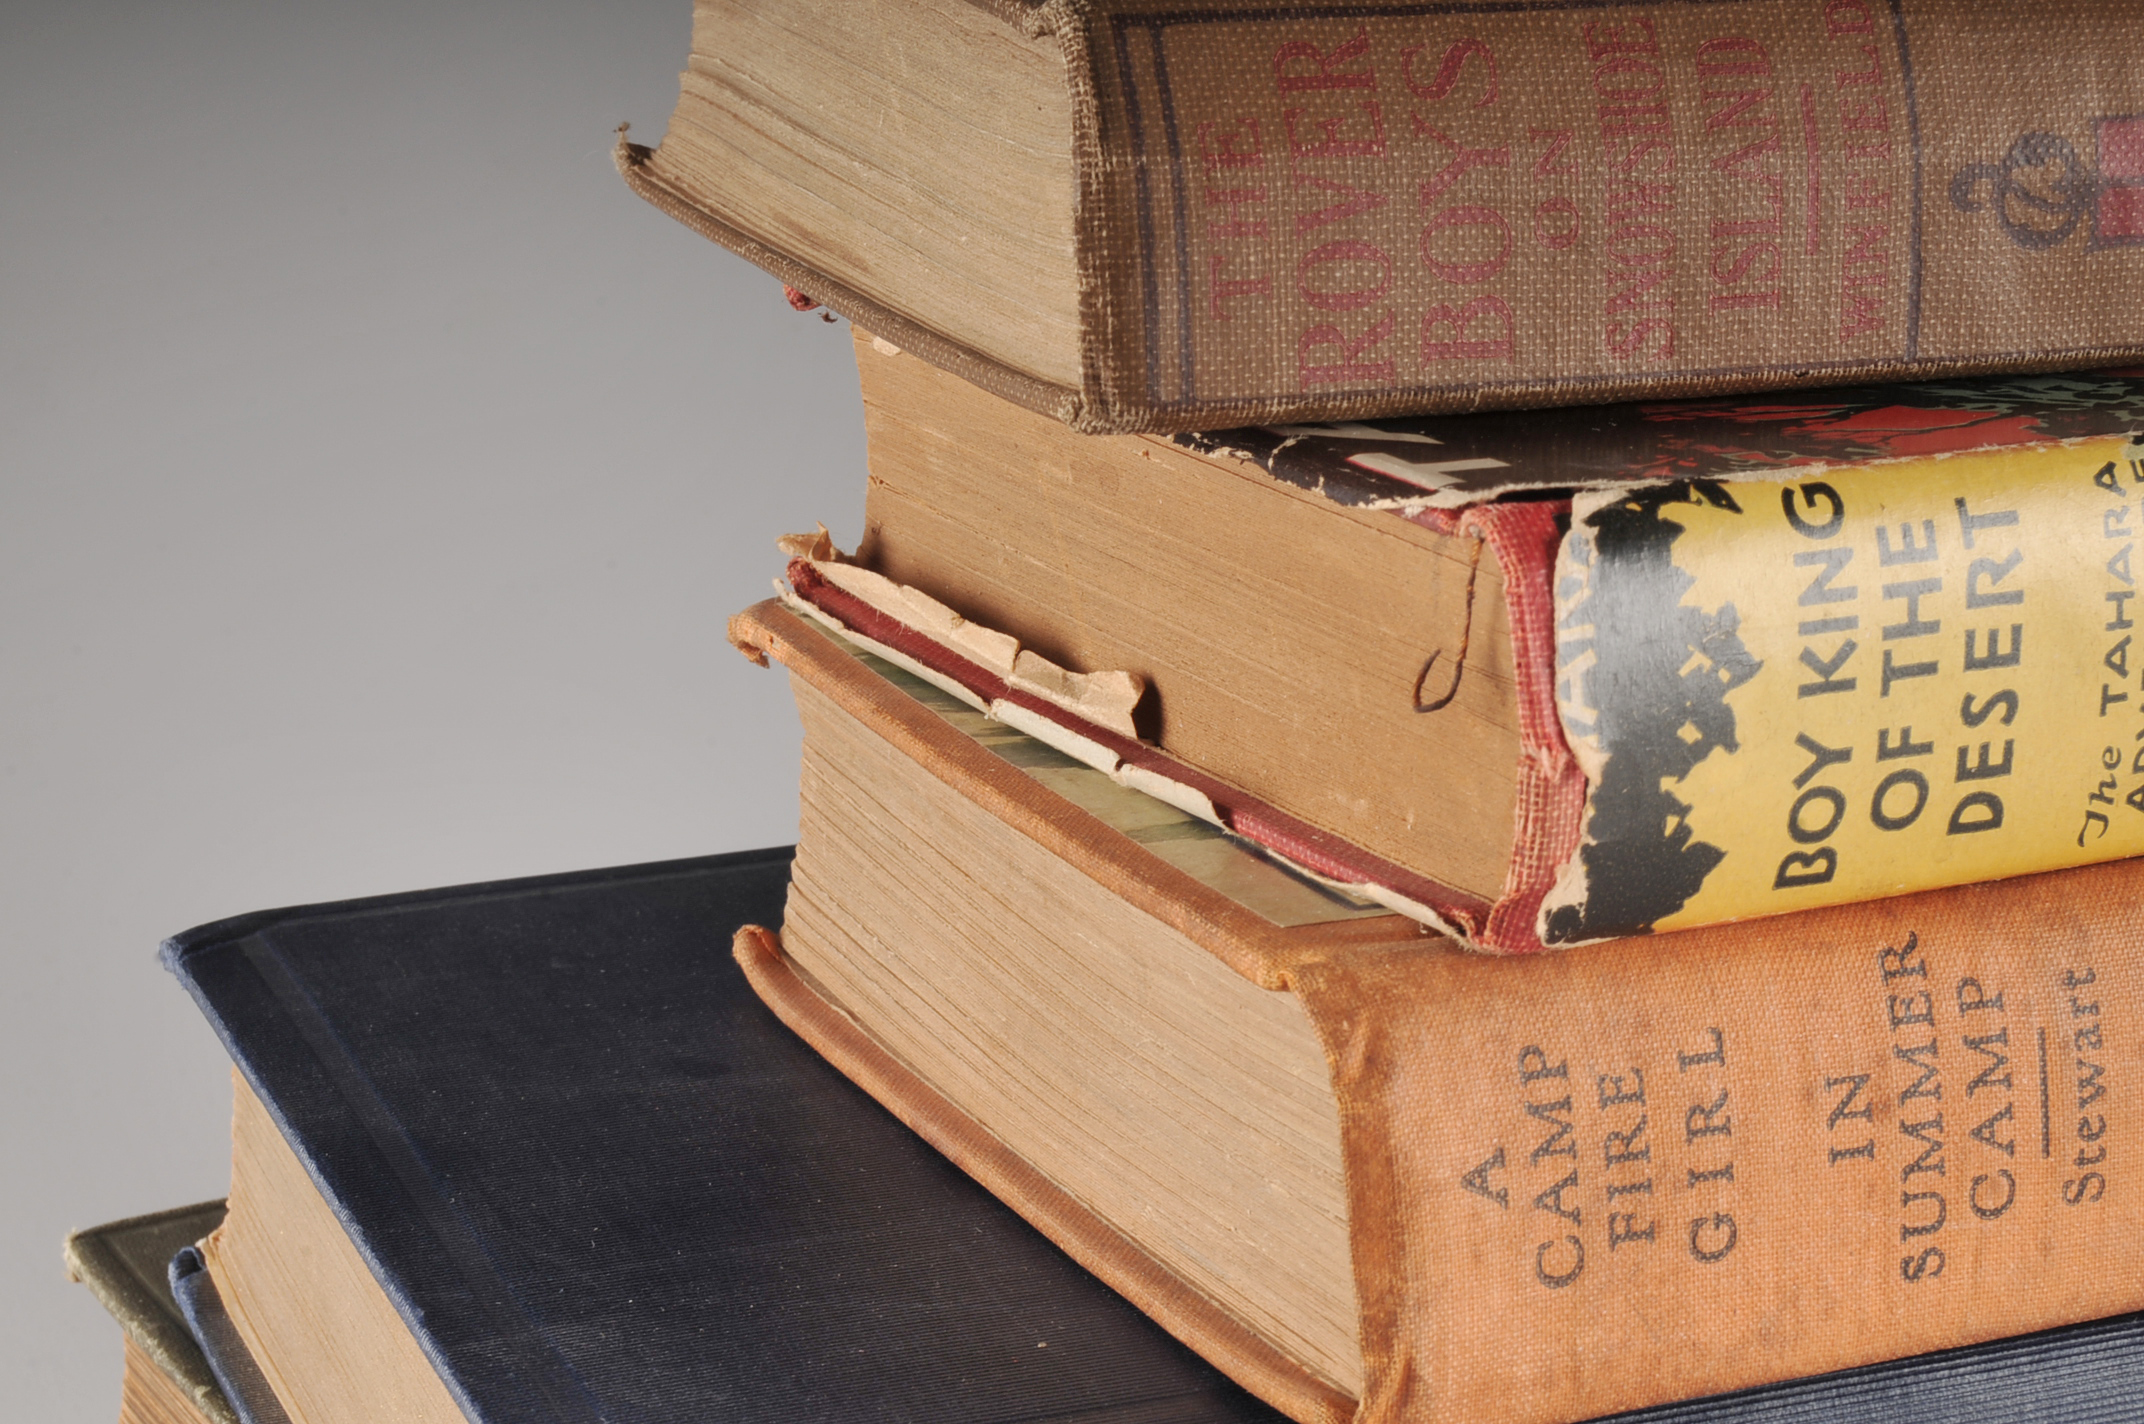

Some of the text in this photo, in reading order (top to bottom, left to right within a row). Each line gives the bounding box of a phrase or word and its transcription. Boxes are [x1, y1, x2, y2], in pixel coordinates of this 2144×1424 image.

[1196, 117, 1273, 322] THE
[1273, 25, 1395, 394] ROVER
[1400, 38, 1513, 370] BOYS
[1529, 126, 1580, 250] ON
[1583, 16, 1676, 363] SNOWSHOE
[1696, 36, 1783, 318] ISLAND
[1825, 1, 1891, 344] WINFIELD
[1772, 481, 1860, 890] BOY KING
[1870, 518, 1943, 832] OF THE
[1946, 496, 2025, 836] DESERT
[2093, 460, 2136, 717] TAHARA
[2077, 745, 2122, 847] The
[1460, 1145, 1508, 1210] A
[1517, 1044, 1585, 1289] CAMP
[1598, 1066, 1656, 1252] FIRE
[1677, 1026, 1737, 1264] GIRL
[1824, 1073, 1875, 1166] IN
[1877, 930, 1947, 1283] SUMMER
[1956, 976, 2016, 1220] CAMP
[2062, 966, 2107, 1207] Stewart
